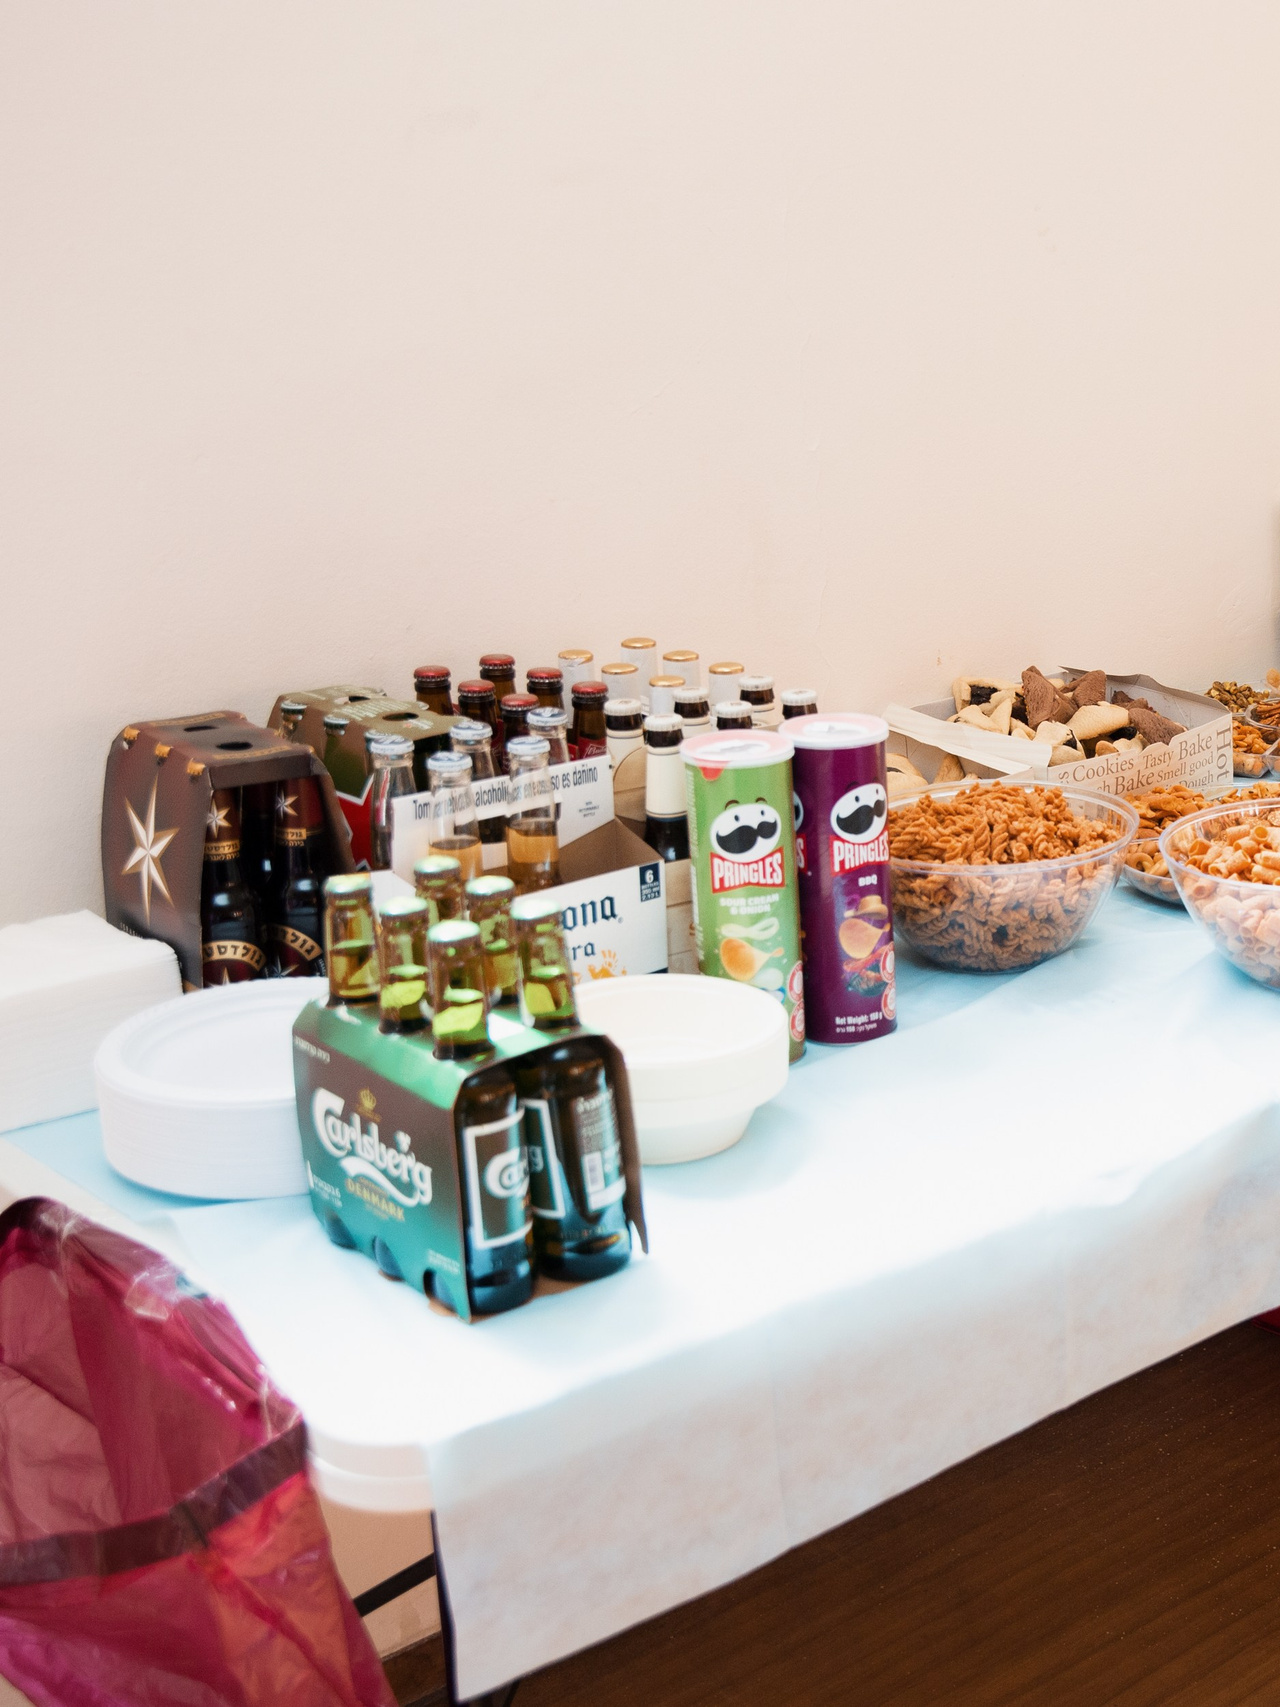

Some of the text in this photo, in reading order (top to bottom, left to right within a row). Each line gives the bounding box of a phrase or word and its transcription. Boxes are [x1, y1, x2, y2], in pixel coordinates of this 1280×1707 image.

[1073, 758, 1134, 782] Cookies
[1143, 750, 1174, 770] Tasty
[1178, 733, 1212, 761] Bake
[1216, 727, 1232, 781] Hot
[562, 773, 571, 788] es
[573, 764, 598, 787] dañino
[1114, 768, 1155, 796] Bake
[1157, 764, 1187, 784] Smell
[1189, 751, 1214, 776] good
[203, 843, 239, 853] גולדסט
[833, 836, 889, 872] PRINGLES
[645, 869, 654, 883] 6
[712, 857, 783, 889] PRINGLES
[858, 875, 878, 886] BBQ
[561, 896, 617, 931] ona
[720, 893, 779, 907] SOUR CREAM
[740, 904, 771, 914] ONION
[204, 944, 263, 968] גולדסט
[312, 1086, 433, 1205] Carlsberg
[345, 1178, 405, 1222] DENMARK
